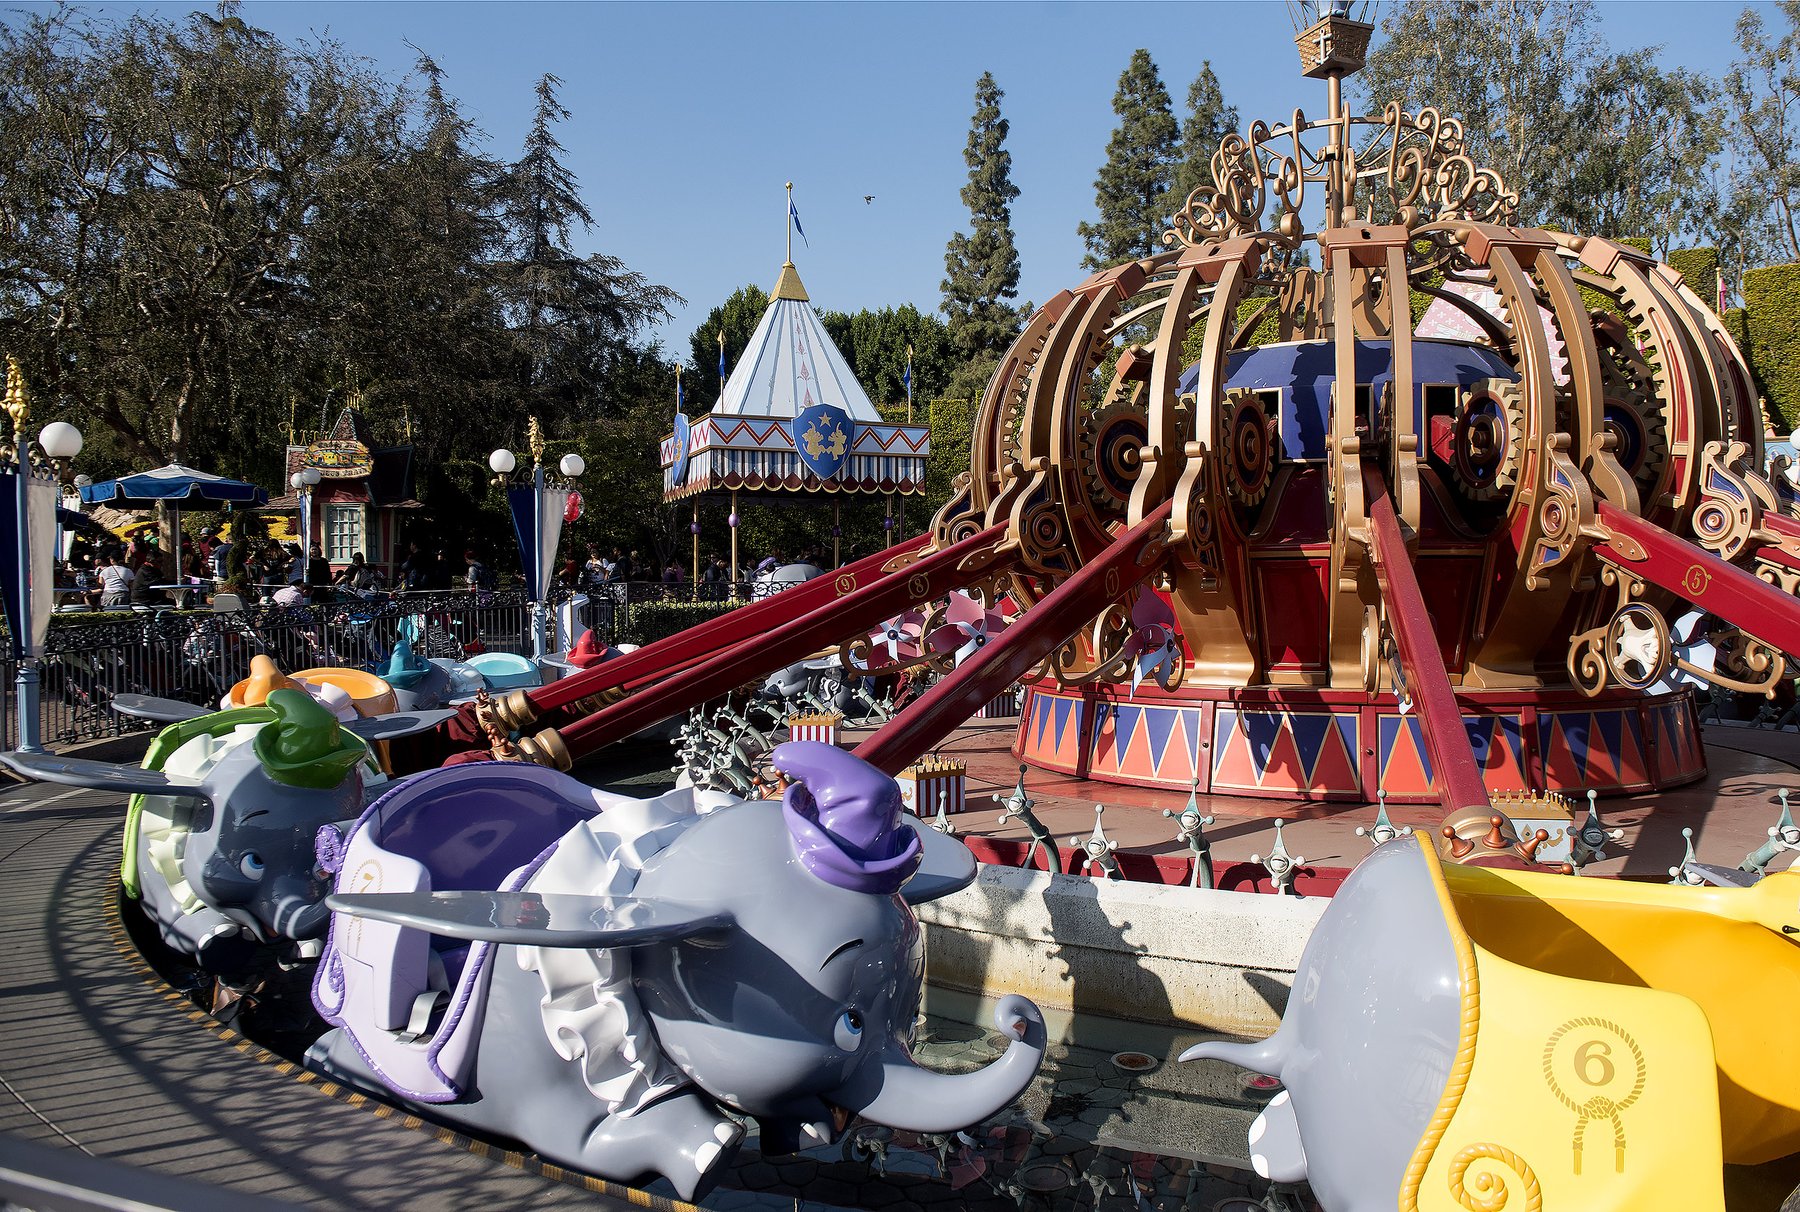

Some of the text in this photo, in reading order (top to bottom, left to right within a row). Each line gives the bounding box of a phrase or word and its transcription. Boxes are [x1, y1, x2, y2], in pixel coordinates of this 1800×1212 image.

[841, 578, 850, 591] 9
[914, 578, 924, 593] 8
[1691, 570, 1702, 590] 5
[1573, 1040, 1615, 1087] 6
